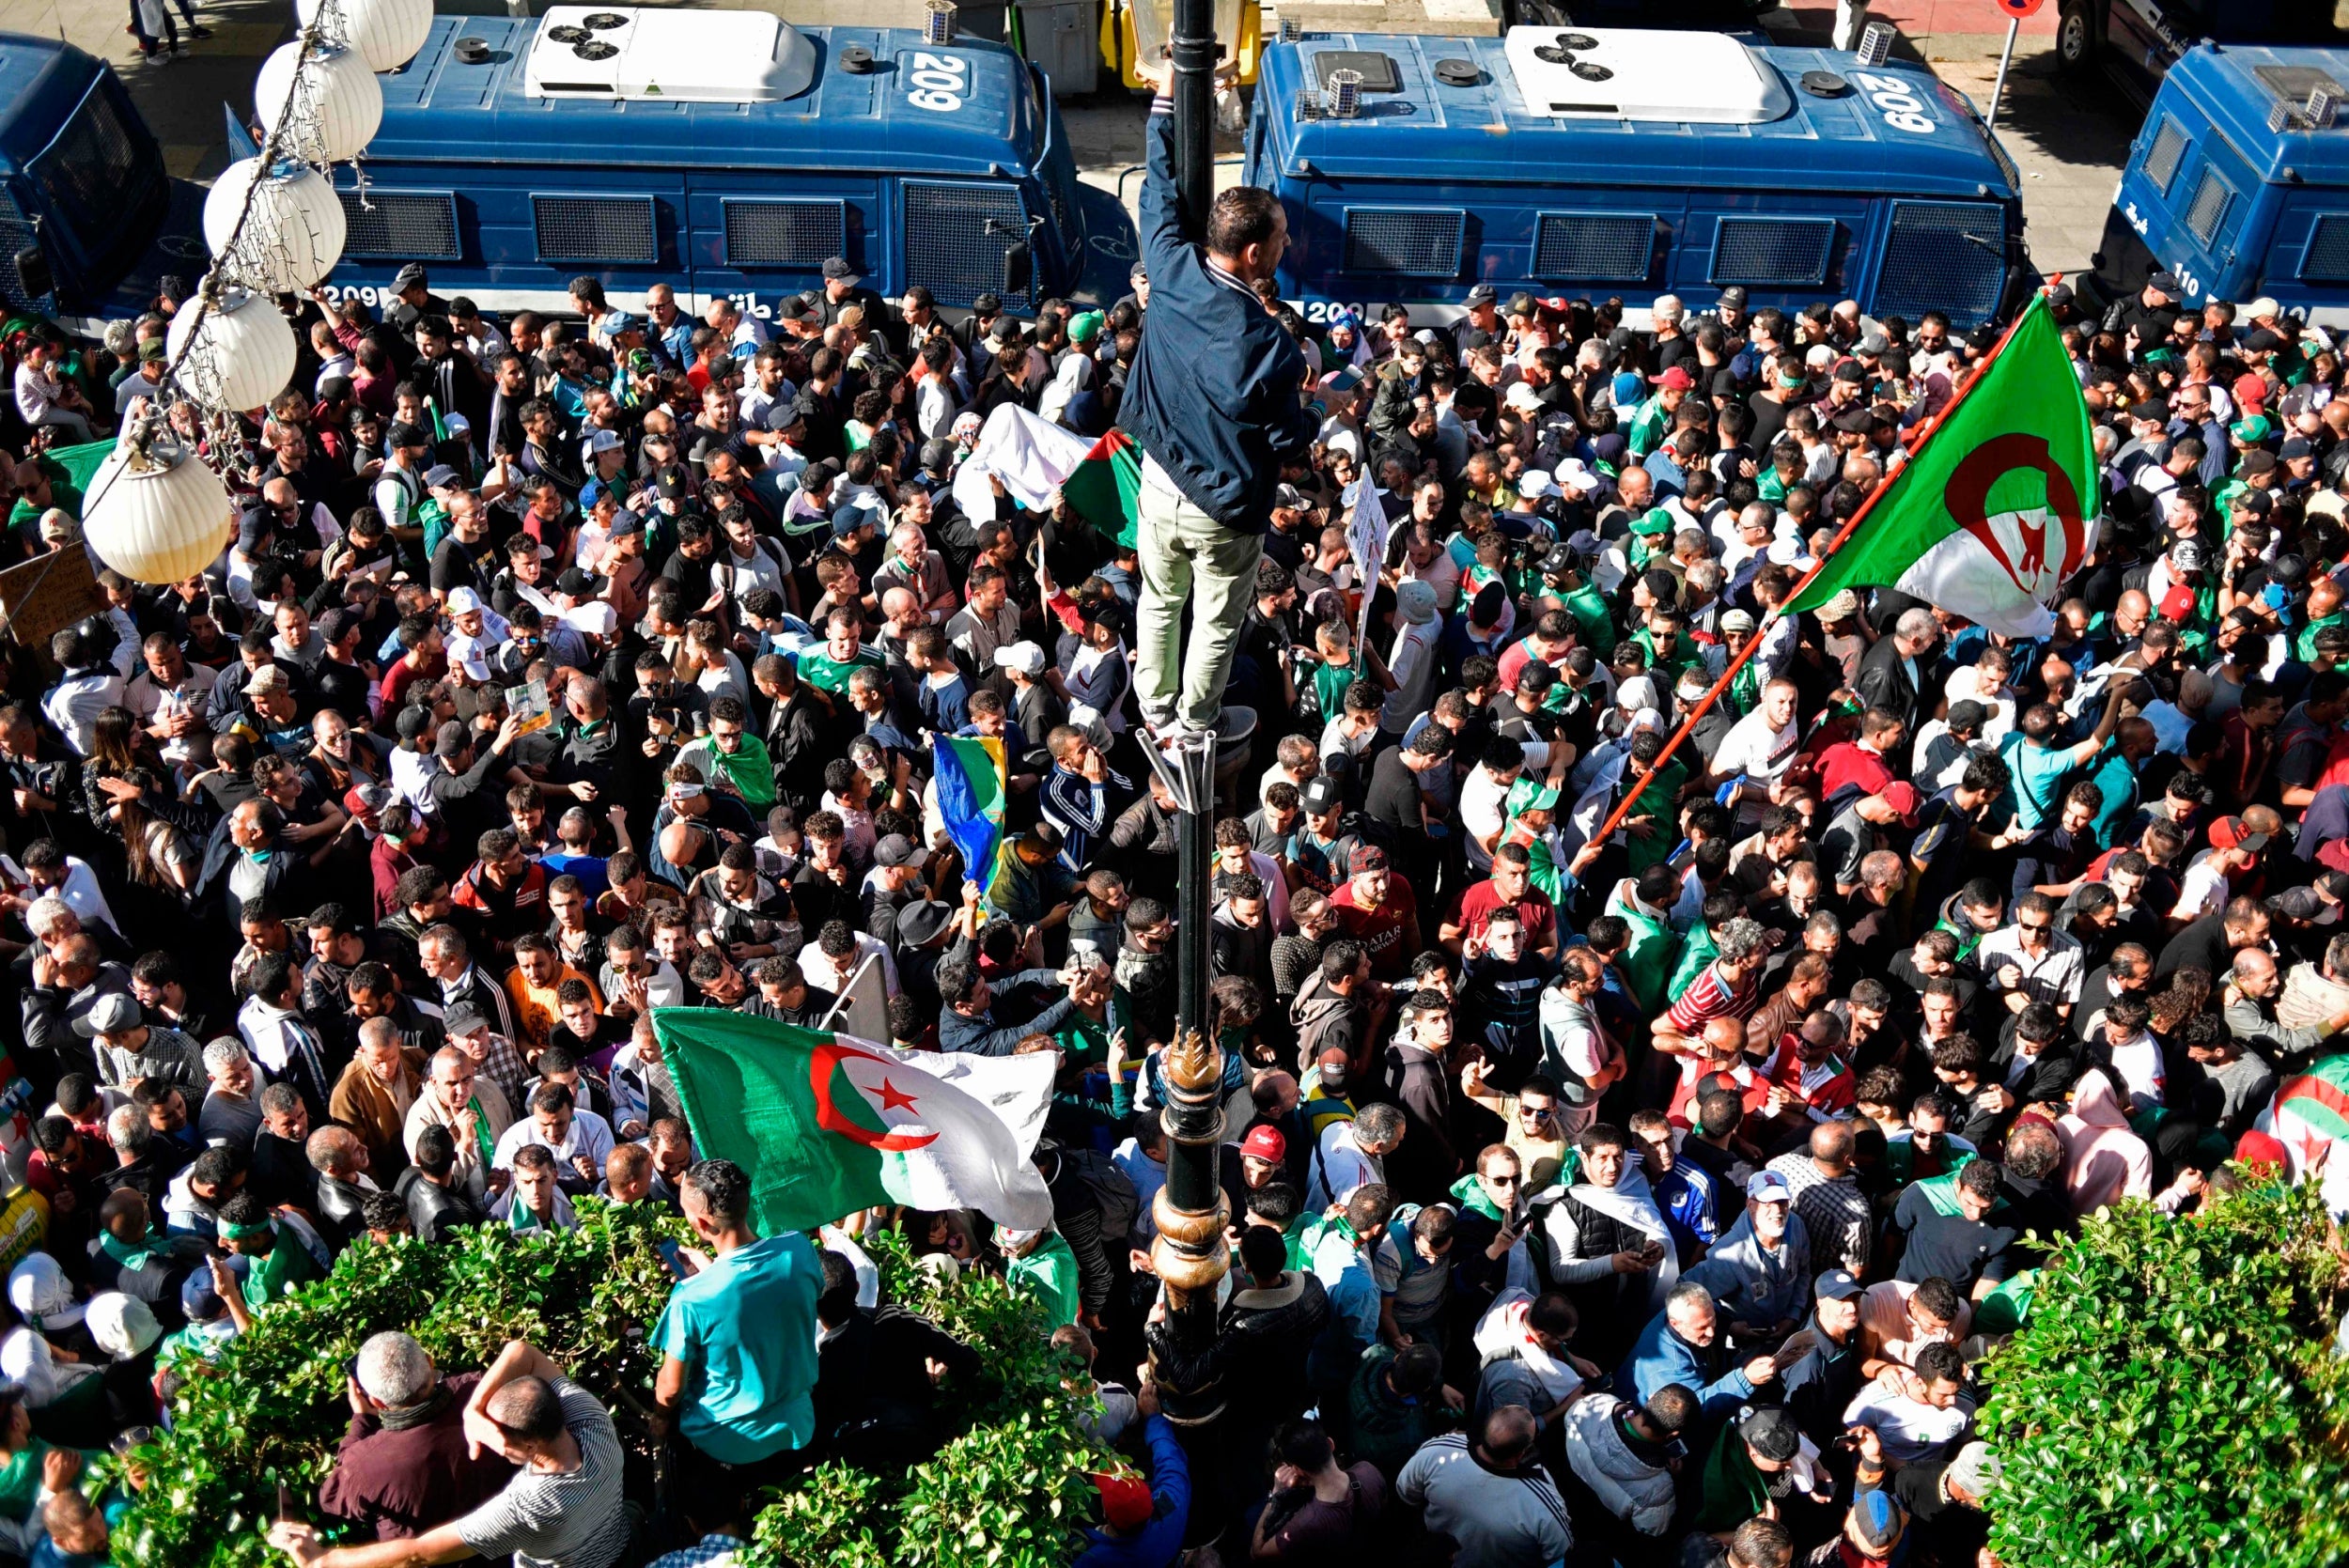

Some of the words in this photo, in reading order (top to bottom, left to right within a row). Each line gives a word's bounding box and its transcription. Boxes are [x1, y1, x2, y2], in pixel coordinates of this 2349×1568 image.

[908, 52, 966, 112] 209
[1857, 72, 1936, 133] 209
[323, 286, 378, 308] 209
[2174, 262, 2200, 297] 110
[1307, 302, 1364, 323] 209
